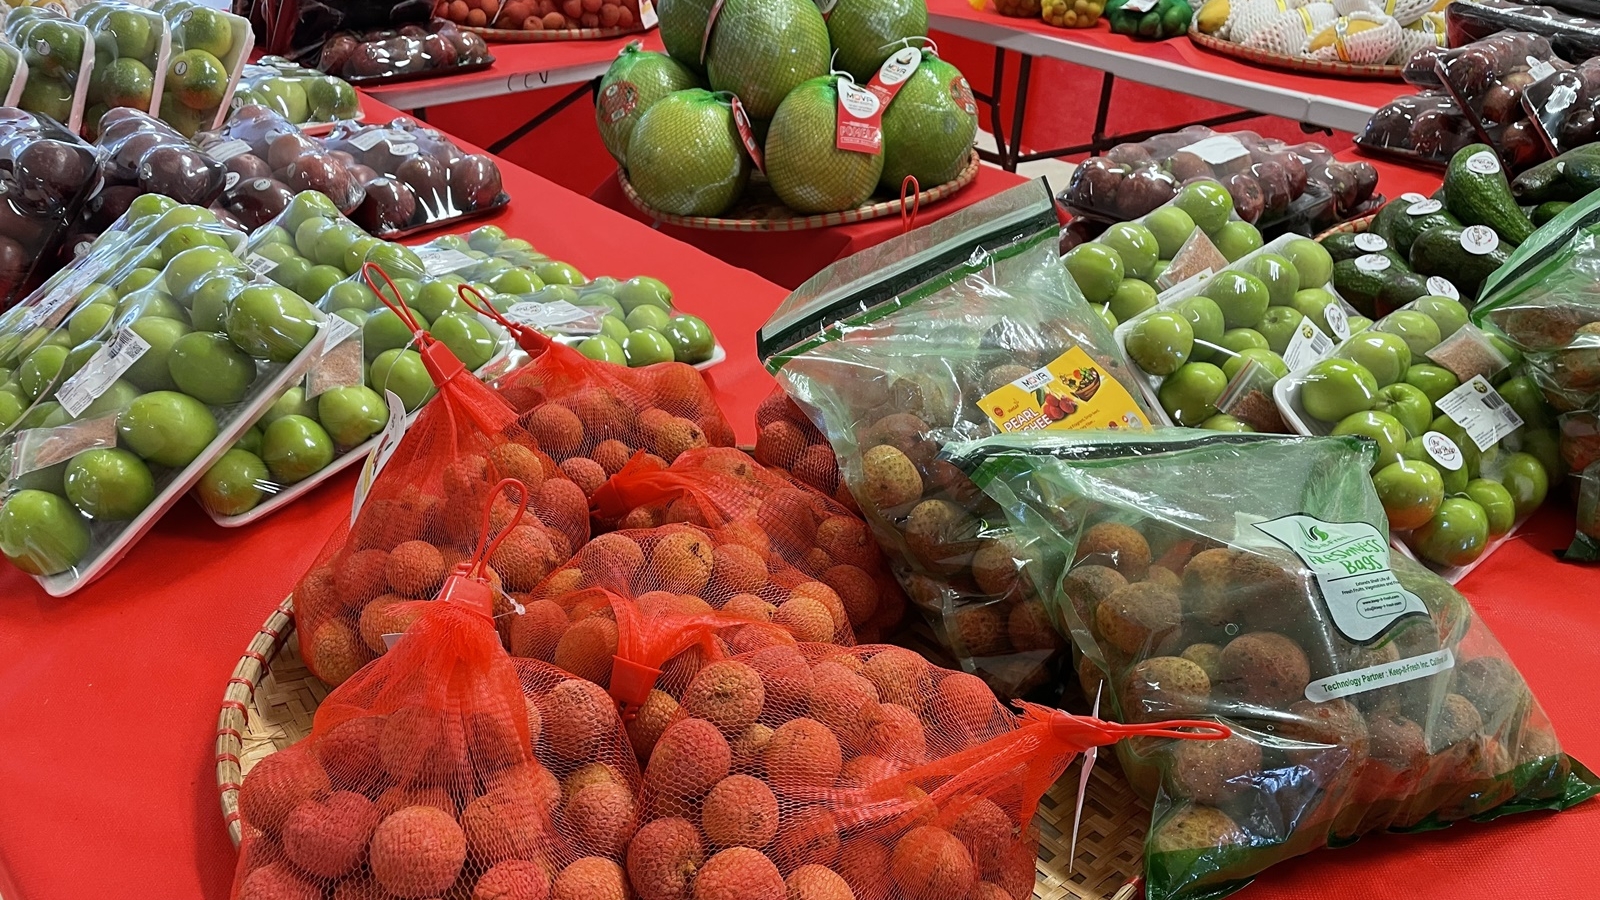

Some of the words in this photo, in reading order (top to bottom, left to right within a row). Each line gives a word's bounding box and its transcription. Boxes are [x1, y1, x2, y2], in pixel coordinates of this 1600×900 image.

[1003, 407, 1040, 432] PEARL
[1021, 414, 1053, 431] CHEE
[1339, 555, 1383, 574] Bags
[1321, 677, 1362, 693] Technology
[1361, 671, 1385, 683] Partner
